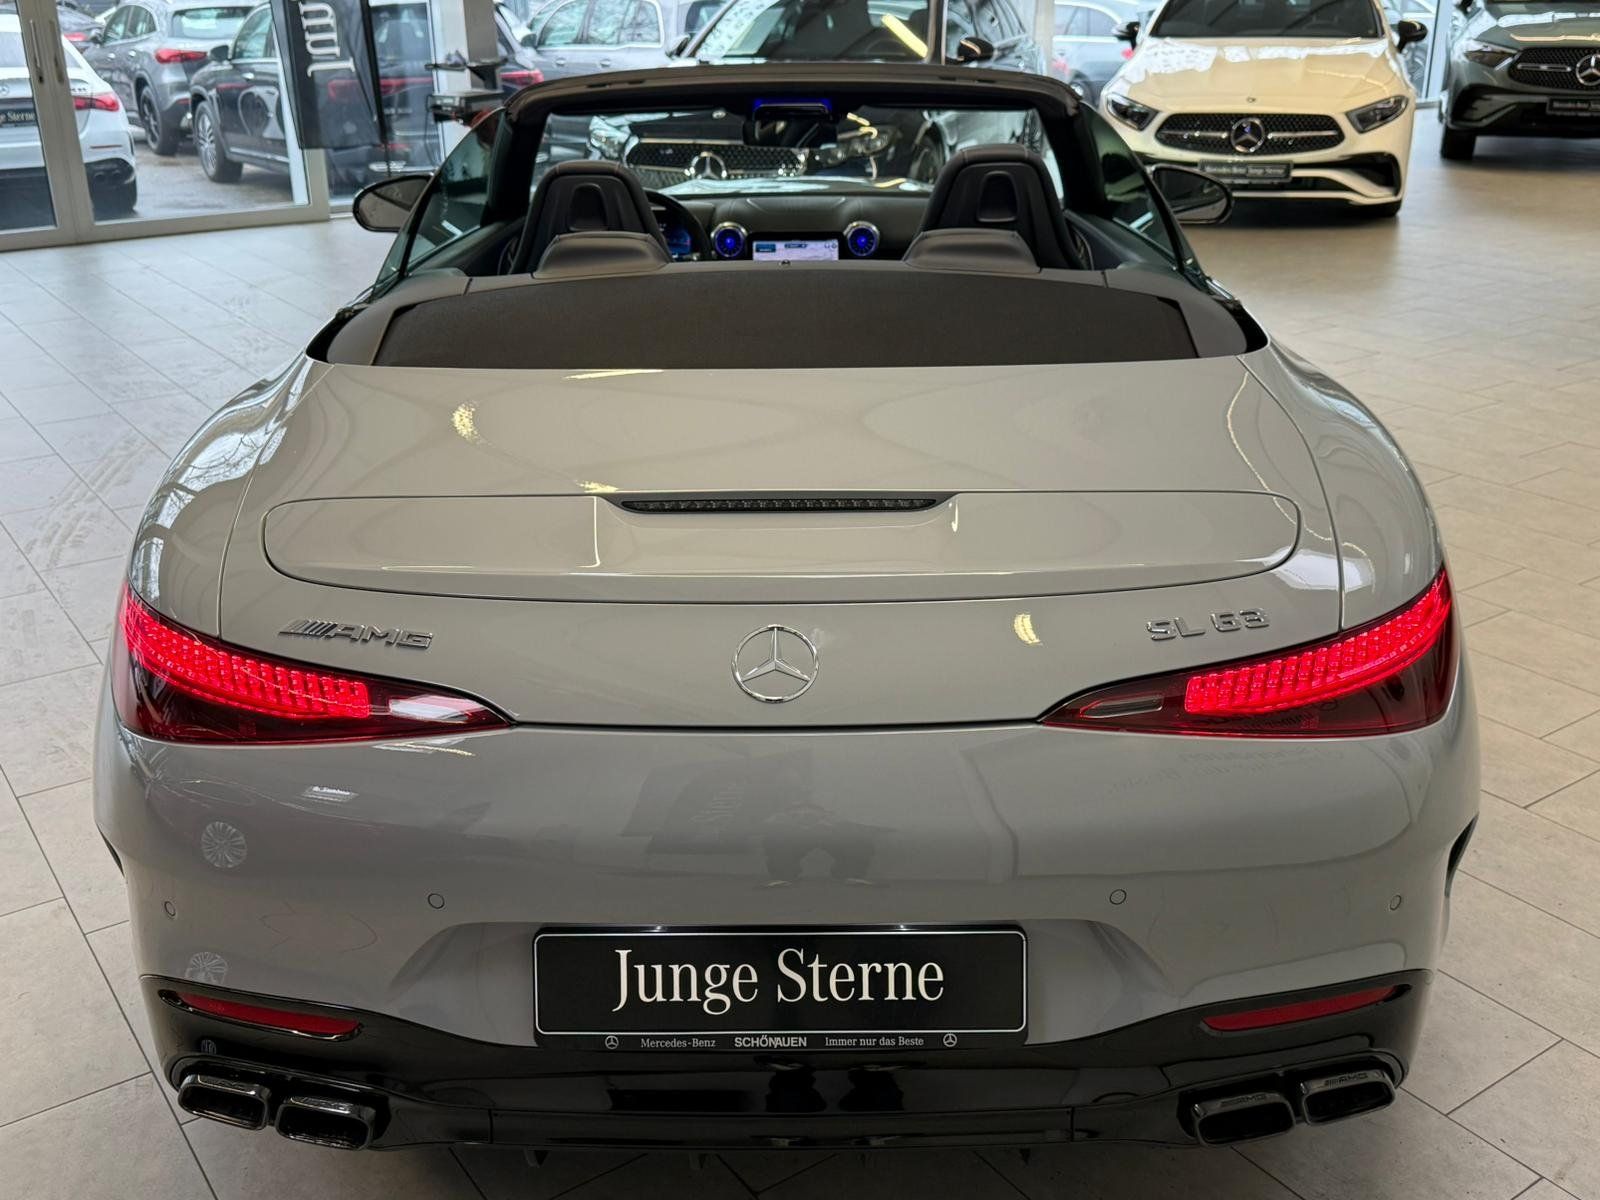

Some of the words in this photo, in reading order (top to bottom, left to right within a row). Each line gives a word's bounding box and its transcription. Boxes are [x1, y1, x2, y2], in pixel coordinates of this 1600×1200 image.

[320, 620, 434, 650] AMG
[1146, 616, 1206, 641] SL
[1209, 608, 1270, 633] 63
[612, 949, 758, 1015] Junge
[777, 948, 944, 1003] Sterne
[640, 1037, 716, 1048] Mercedes-Benz
[734, 1035, 807, 1048] SCHÖNAUEN
[825, 1036, 857, 1047] Immer
[859, 1037, 876, 1047] nur
[879, 1036, 896, 1047] das
[898, 1036, 925, 1047] Beste
